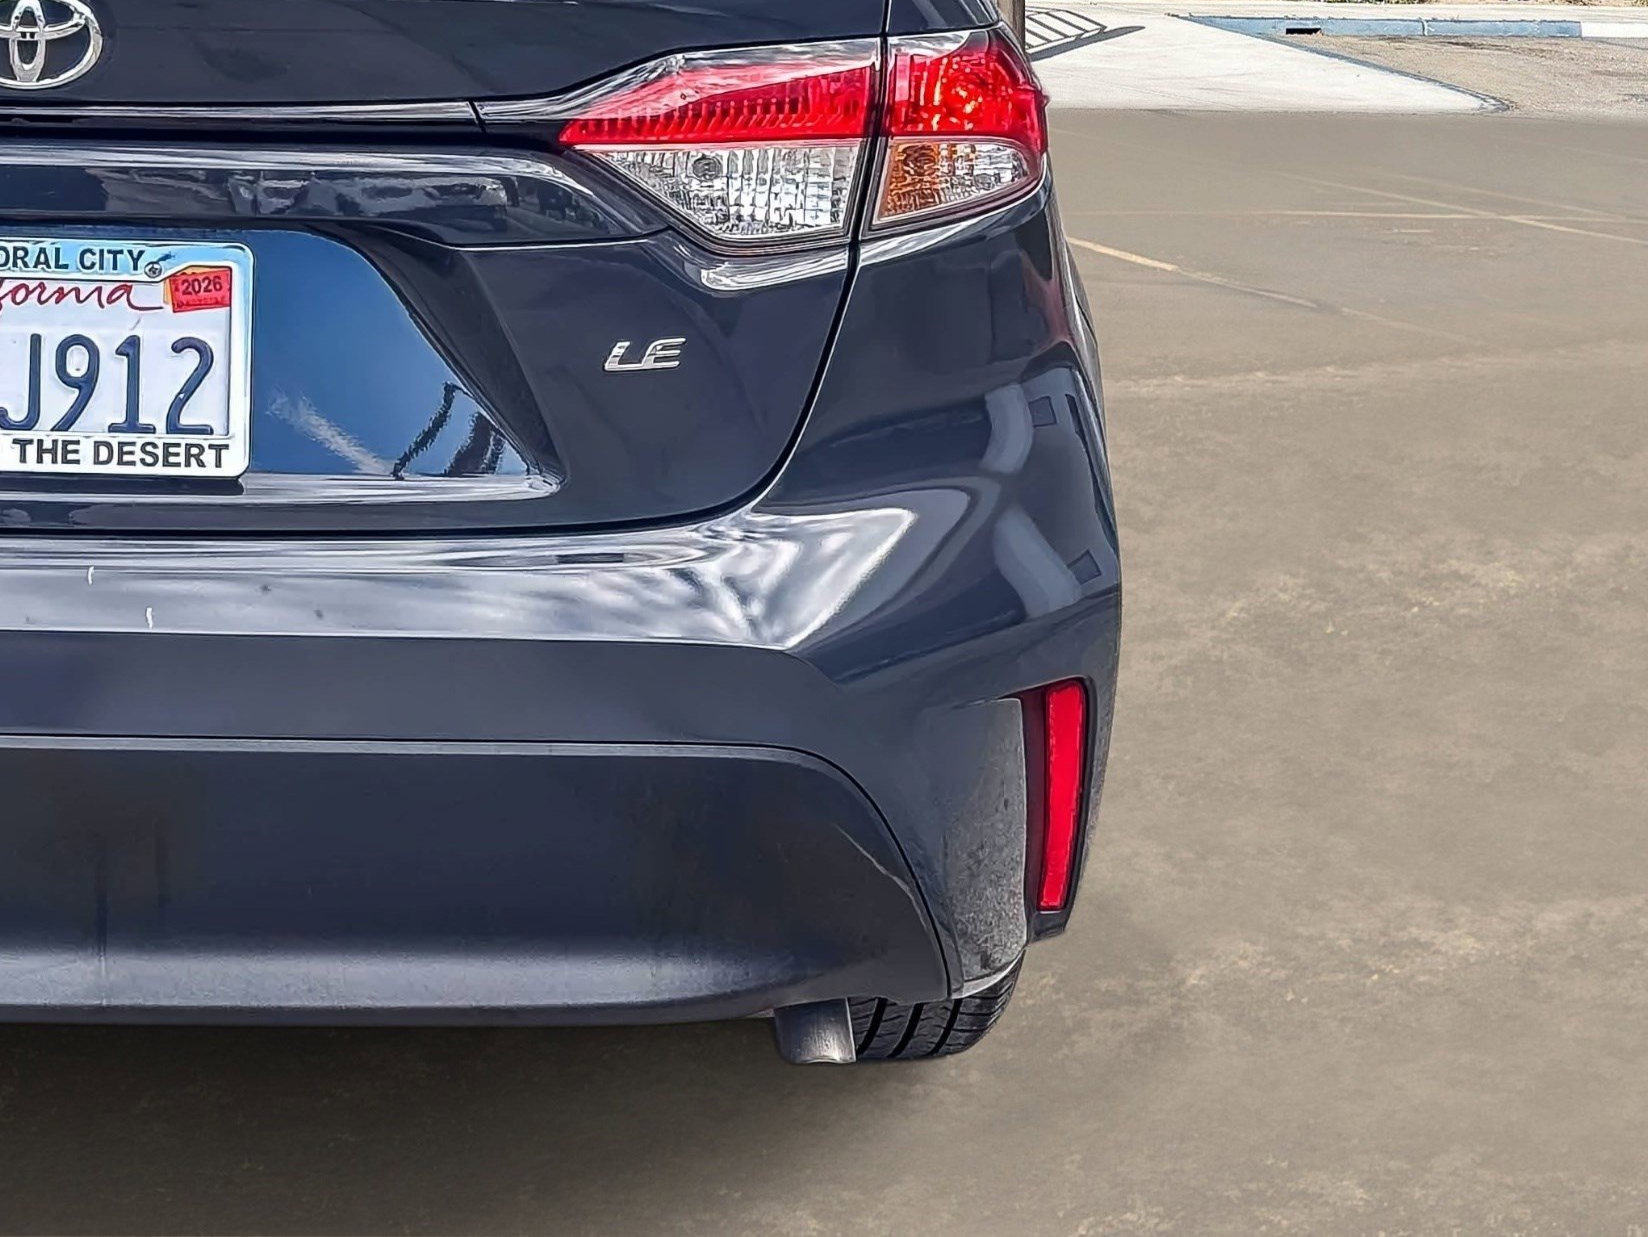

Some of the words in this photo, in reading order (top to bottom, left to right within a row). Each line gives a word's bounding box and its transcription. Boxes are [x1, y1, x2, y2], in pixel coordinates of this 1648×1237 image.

[79, 247, 146, 272] CITY
[180, 275, 224, 296] 2026
[603, 337, 687, 371] LE
[12, 438, 81, 465] THE
[93, 440, 230, 469] DESERT
